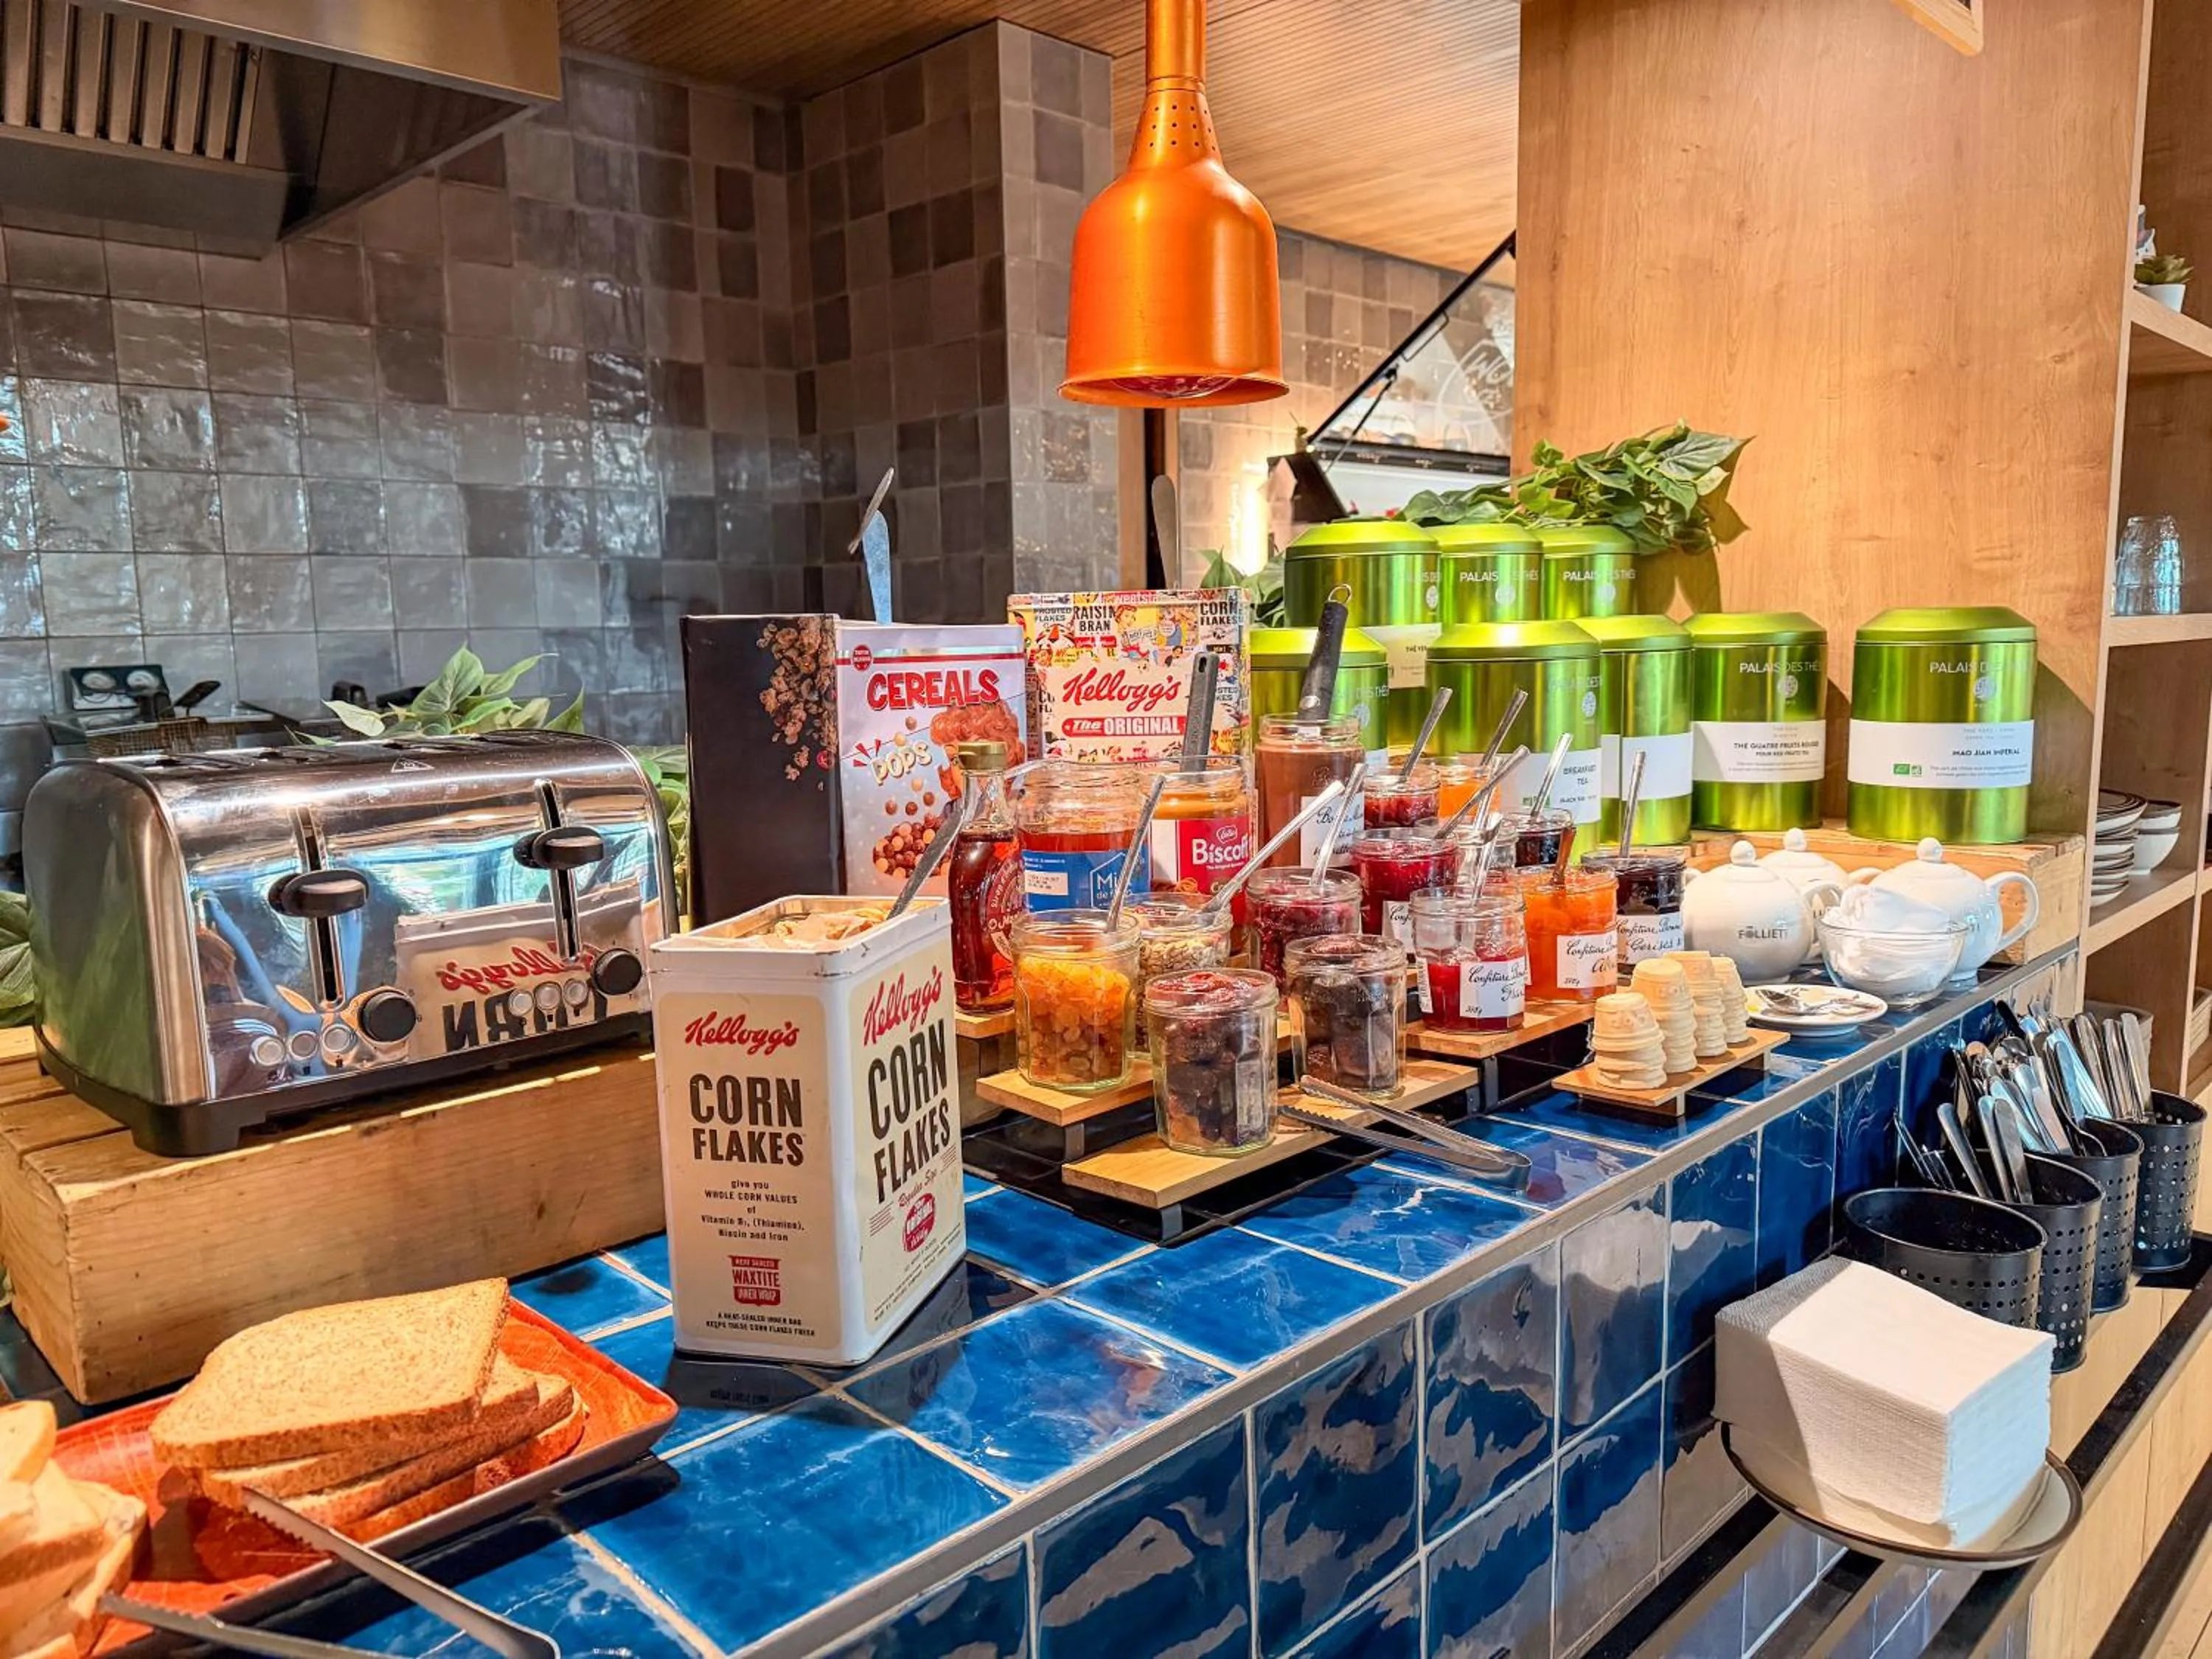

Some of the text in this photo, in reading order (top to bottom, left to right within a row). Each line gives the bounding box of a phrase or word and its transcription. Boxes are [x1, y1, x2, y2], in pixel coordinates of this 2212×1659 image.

[1074, 605, 1116, 620] RAISIN
[1200, 601, 1238, 615] CORN
[1079, 621, 1110, 632] BRAN
[1200, 616, 1239, 625] FLAKES
[1739, 662, 1781, 673] PALAIS
[867, 669, 1001, 711] CEREALS
[1062, 667, 1181, 712] Kellogg's
[1072, 717, 1180, 735] The ORIGINAL
[871, 741, 933, 786] POPS
[1566, 939, 1605, 959] Confiture
[1468, 966, 1510, 987] Confiture
[863, 965, 943, 1047] Kellogg's
[685, 1011, 800, 1055] Kellogg's
[868, 1018, 947, 1141] CORN
[689, 1073, 802, 1127] CORN
[692, 1127, 804, 1166] FLAKES
[874, 1097, 950, 1204] FLAKES
[731, 1180, 769, 1190] give you
[705, 1189, 798, 1204] WHOLE CORN VALUES
[701, 1215, 735, 1225] Vitamin
[750, 1231, 766, 1239] and
[769, 1232, 788, 1241] Iron
[732, 1269, 780, 1287] WAXTITE
